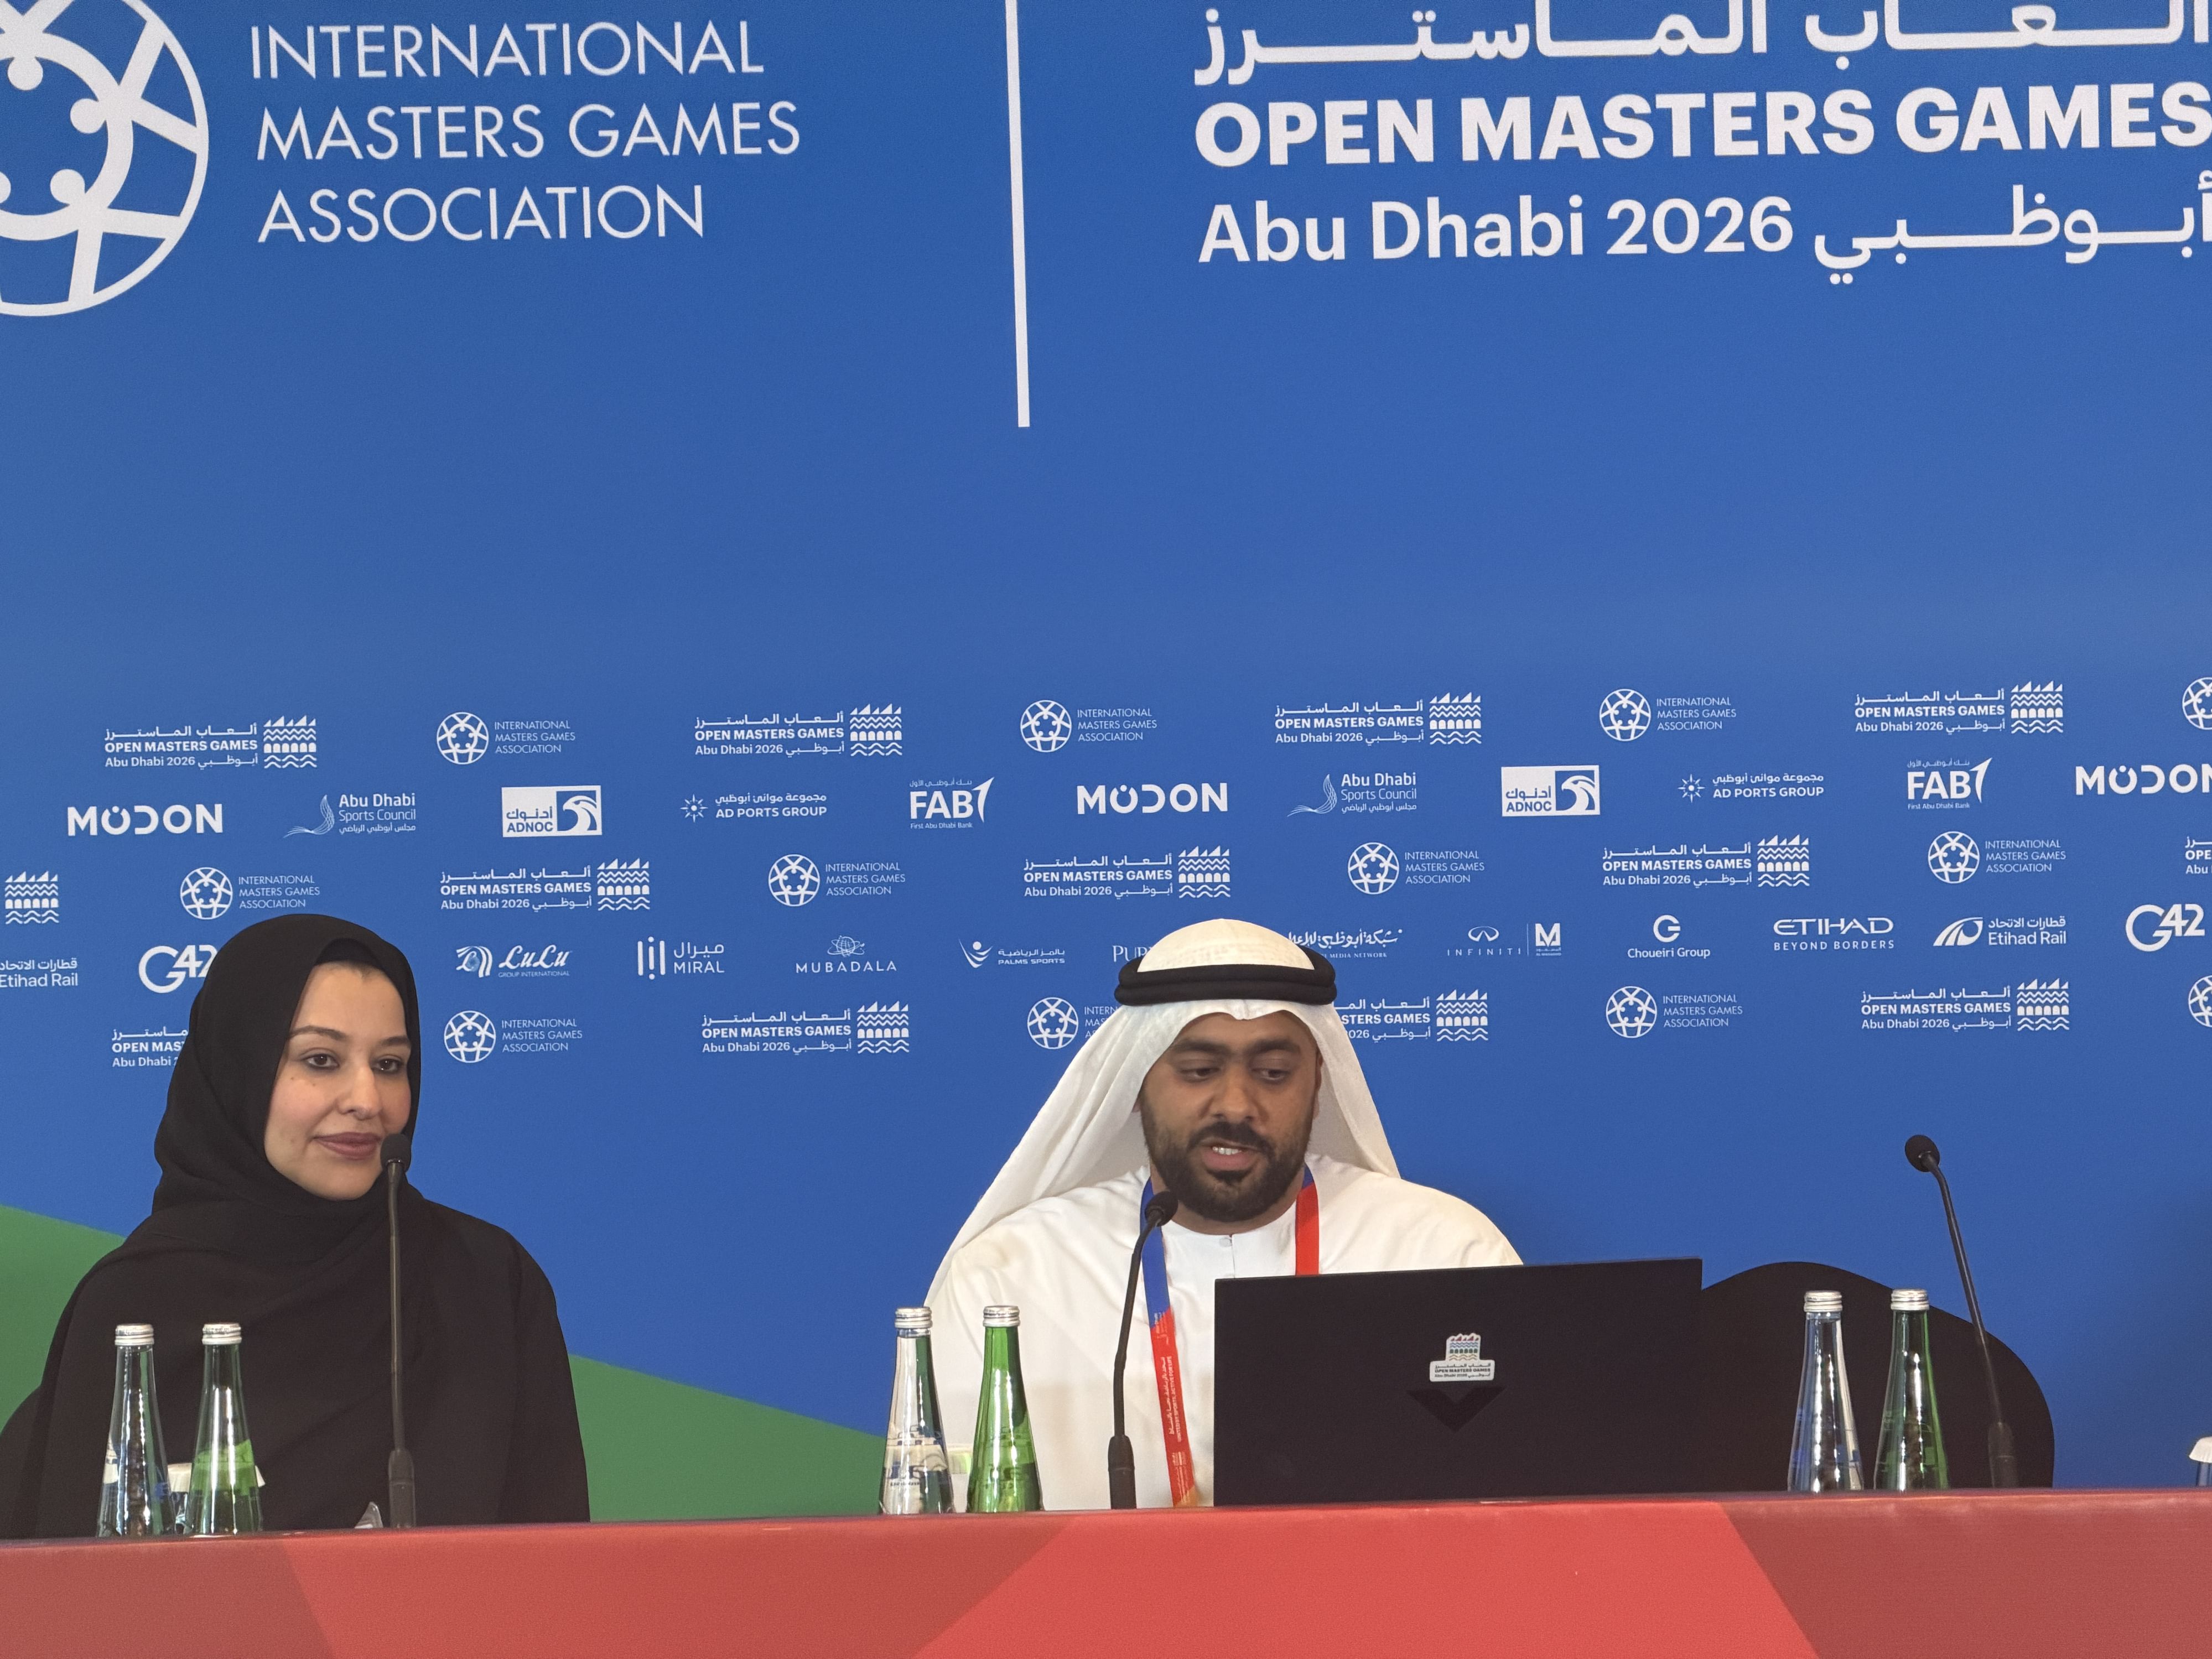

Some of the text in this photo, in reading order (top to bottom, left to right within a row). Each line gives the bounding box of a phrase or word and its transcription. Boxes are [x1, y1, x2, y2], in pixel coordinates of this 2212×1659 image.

[252, 20, 764, 79] INTERNATIONAL
[1196, 81, 2212, 167] OPEN MASTERS GAMES
[257, 101, 799, 160] MASTERS GAMES
[258, 185, 703, 242] ASSOCIATION
[1199, 200, 1345, 262] Abu
[1372, 195, 1583, 259] Dhabi
[1607, 196, 1793, 254] 2026
[1657, 697, 1731, 706] INTERNATIONAL
[1658, 709, 1736, 718] MASTERS GAMES
[495, 721, 570, 730] INTERNATIONAL
[1275, 716, 1423, 729] OPEN MASTERS GAMES
[1658, 721, 1722, 730] ASSOCIATION
[495, 732, 575, 741] MASTERS GAMES
[1276, 734, 1297, 742] Abu
[1301, 732, 1332, 742] Dhabi
[1336, 733, 1363, 741] 2026
[105, 740, 257, 752] OPEN MASTERS GAMES
[496, 745, 561, 753] ASSOCIATION
[106, 757, 128, 767] Abu
[131, 757, 163, 766] Dhabi
[167, 757, 195, 765] 2026
[1342, 772, 1416, 786] Abu Dhabi
[1908, 771, 1971, 799] FAB
[1341, 788, 1416, 802] Sports Council
[1713, 787, 1824, 798] AD PORTS GROUP
[339, 793, 414, 807] Abu Dhabi
[910, 791, 973, 819] FAB
[1507, 801, 1551, 812] ADNOC
[339, 809, 416, 823] Sports Council
[716, 807, 827, 818] AD PORTS GROUP
[507, 821, 553, 832] ADNOC
[1986, 840, 2060, 849] INTERNATIONAL
[1986, 851, 2066, 860] MASTERS GAMES
[2185, 850, 2212, 860] OPE
[1986, 864, 2052, 872] ASSOCIATION
[239, 876, 314, 885] INTERNATIONAL
[1024, 870, 1172, 882] OPEN MASTERS GAMES
[240, 887, 319, 896] MASTERS GAMES
[1025, 887, 1046, 896] Abu
[1050, 886, 1081, 896] Dhabi
[1084, 887, 1112, 895] 2026
[240, 899, 305, 908] ASSOCIATION
[1773, 917, 1894, 935] ETIHAD
[2126, 904, 2205, 951] G42
[1989, 931, 2066, 945] Etihad Rail
[1774, 939, 1894, 951] BEYOND BORDERS
[499, 945, 569, 969] LuLu
[1628, 948, 1710, 959] Choueiri Group
[674, 961, 724, 973] MIRAL
[796, 961, 896, 973] MUBADALA
[0, 973, 77, 987] Etihad Rail
[1862, 1002, 2011, 1015] OPEN MASTERS GAMES
[502, 1019, 577, 1028] INTERNATIONAL
[1862, 1020, 1883, 1028] Abu
[1887, 1018, 1919, 1028] Dhabi
[1922, 1019, 1949, 1027] 2026
[503, 1031, 582, 1039] MASTERS GAMES
[503, 1043, 568, 1052] ASSOCIATION
